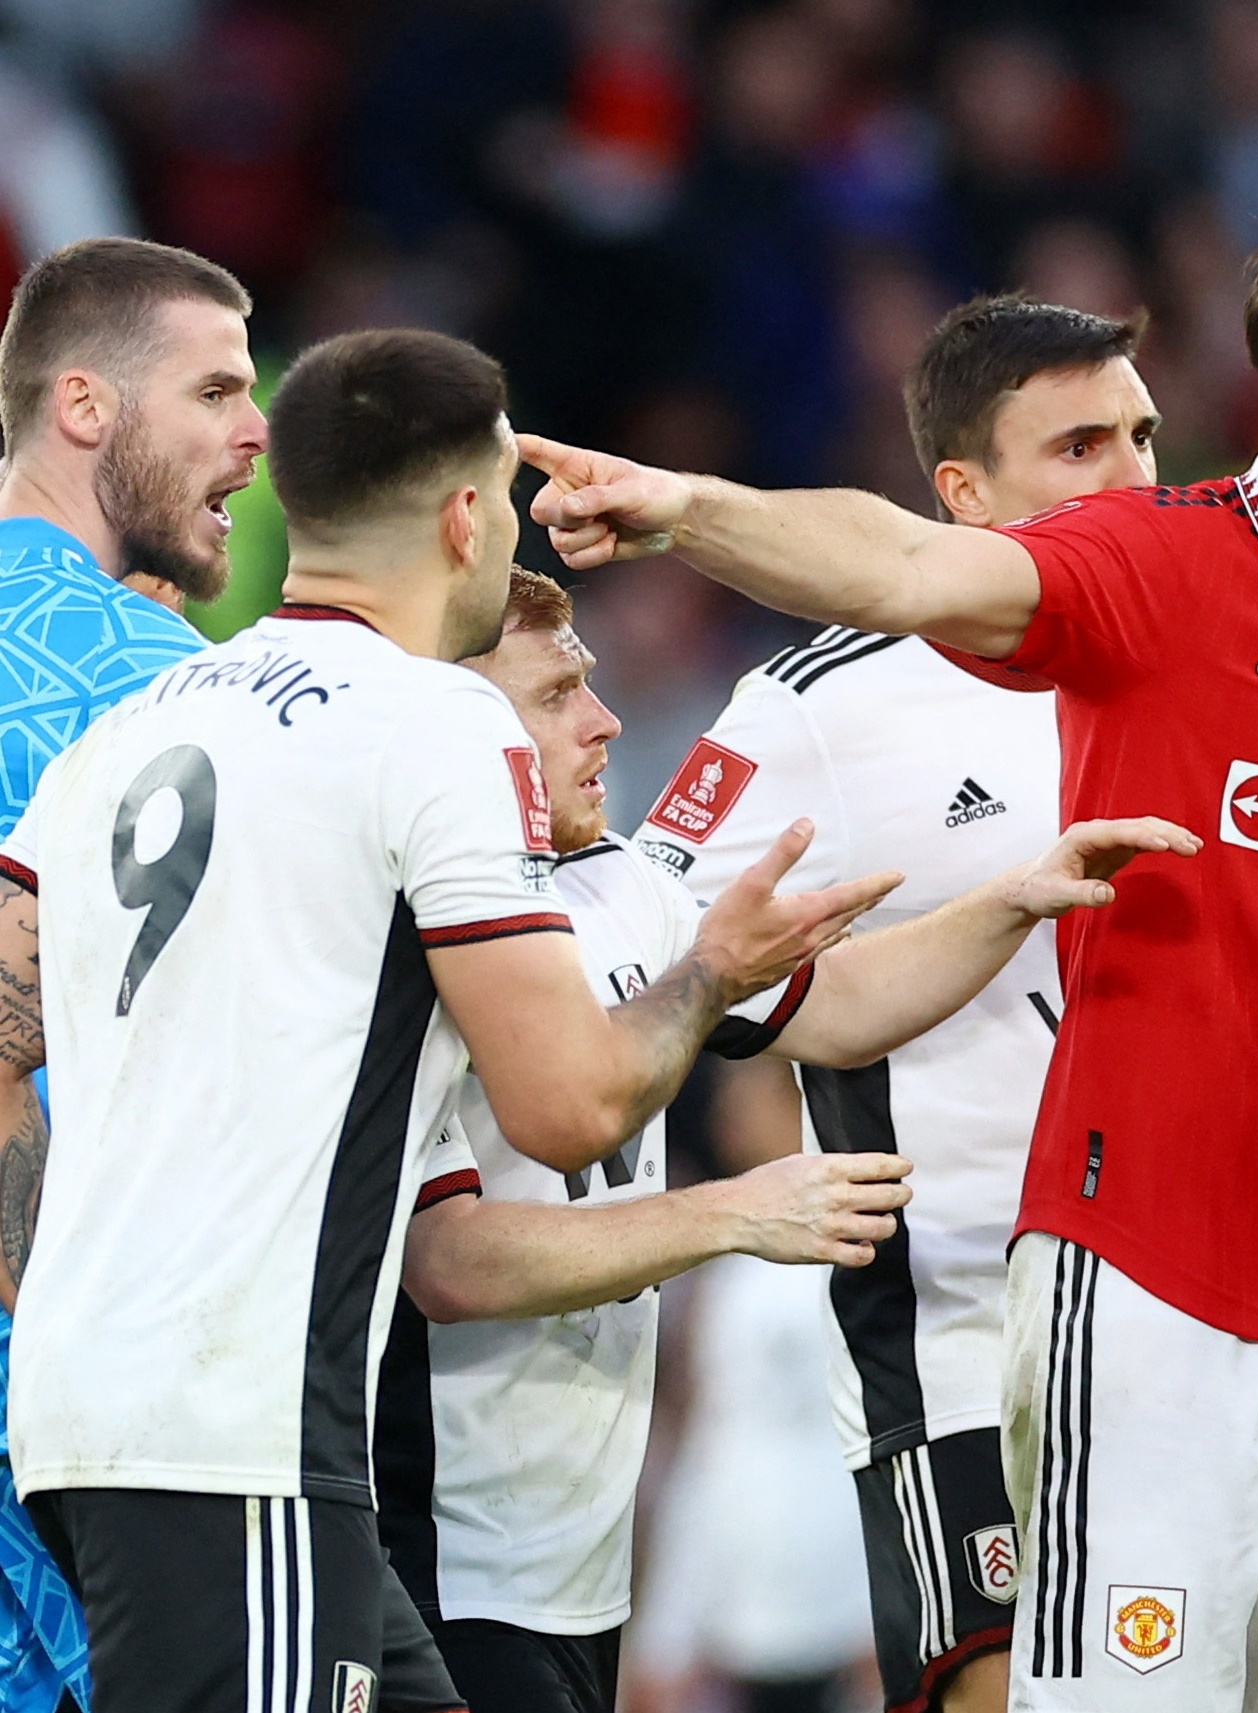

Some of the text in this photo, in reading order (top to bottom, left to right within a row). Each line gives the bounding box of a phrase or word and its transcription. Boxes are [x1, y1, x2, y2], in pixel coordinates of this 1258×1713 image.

[134, 651, 350, 727] ITROVIĆ
[662, 806, 708, 831] FA CUP
[670, 793, 714, 822] Emirates
[945, 801, 1007, 828] adidas
[112, 744, 217, 1017] 9
[983, 1536, 1014, 1588] FFC
